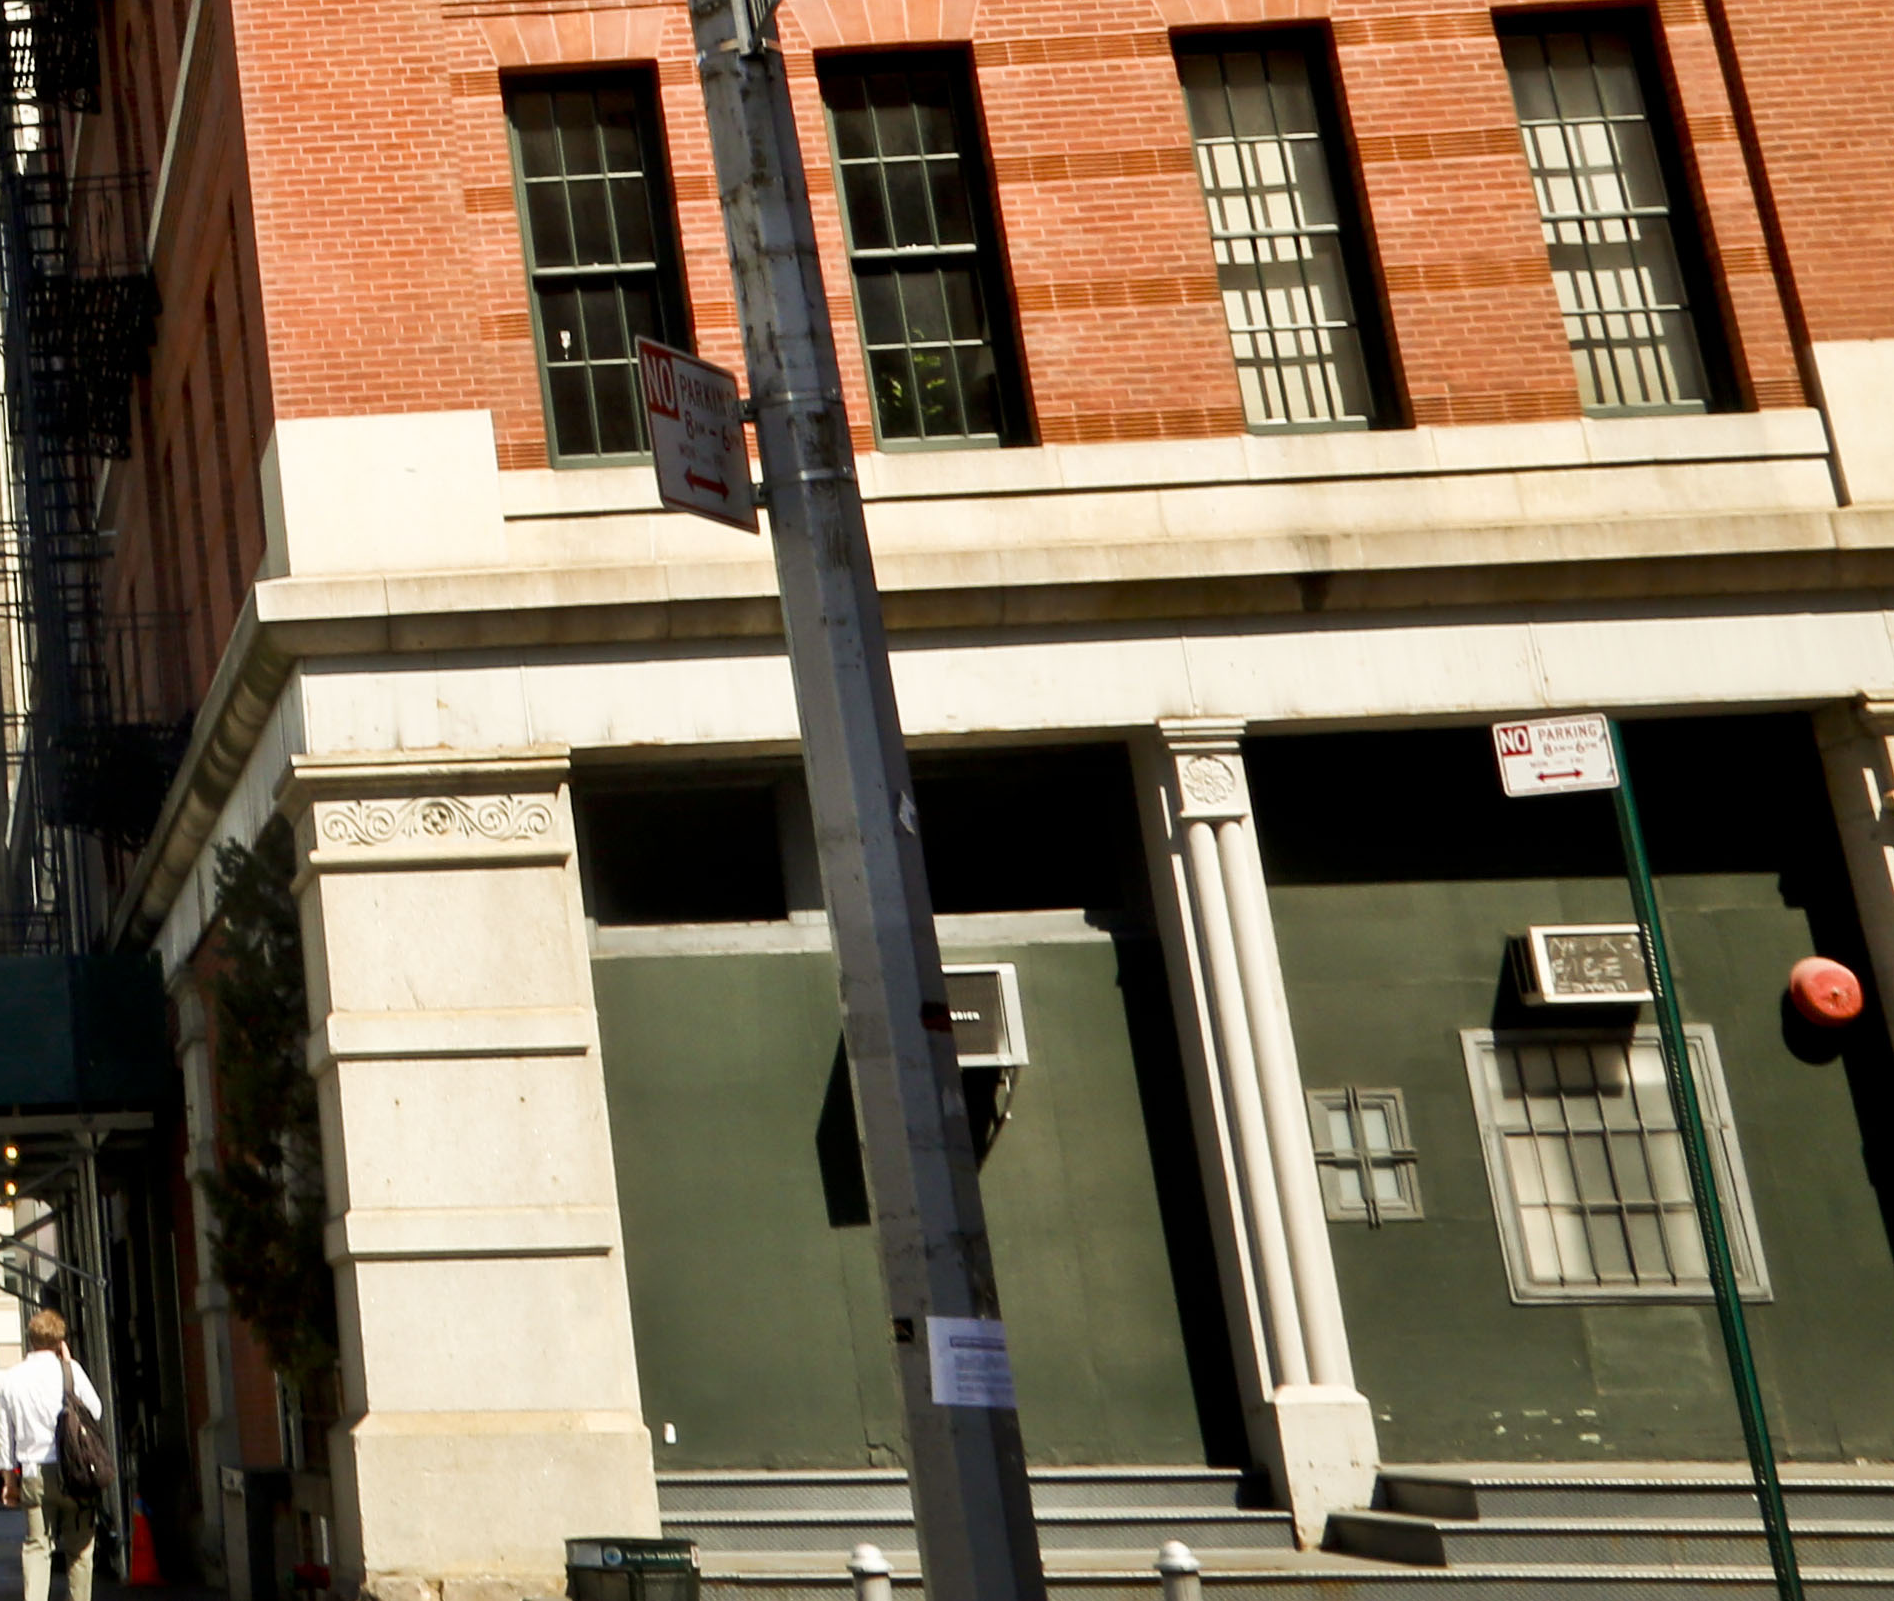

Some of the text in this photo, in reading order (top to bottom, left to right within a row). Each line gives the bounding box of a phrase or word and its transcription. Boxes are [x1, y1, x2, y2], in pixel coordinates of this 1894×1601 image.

[643, 352, 677, 411] NO
[1498, 727, 1530, 754] NO
[1538, 723, 1598, 742] PARKING
